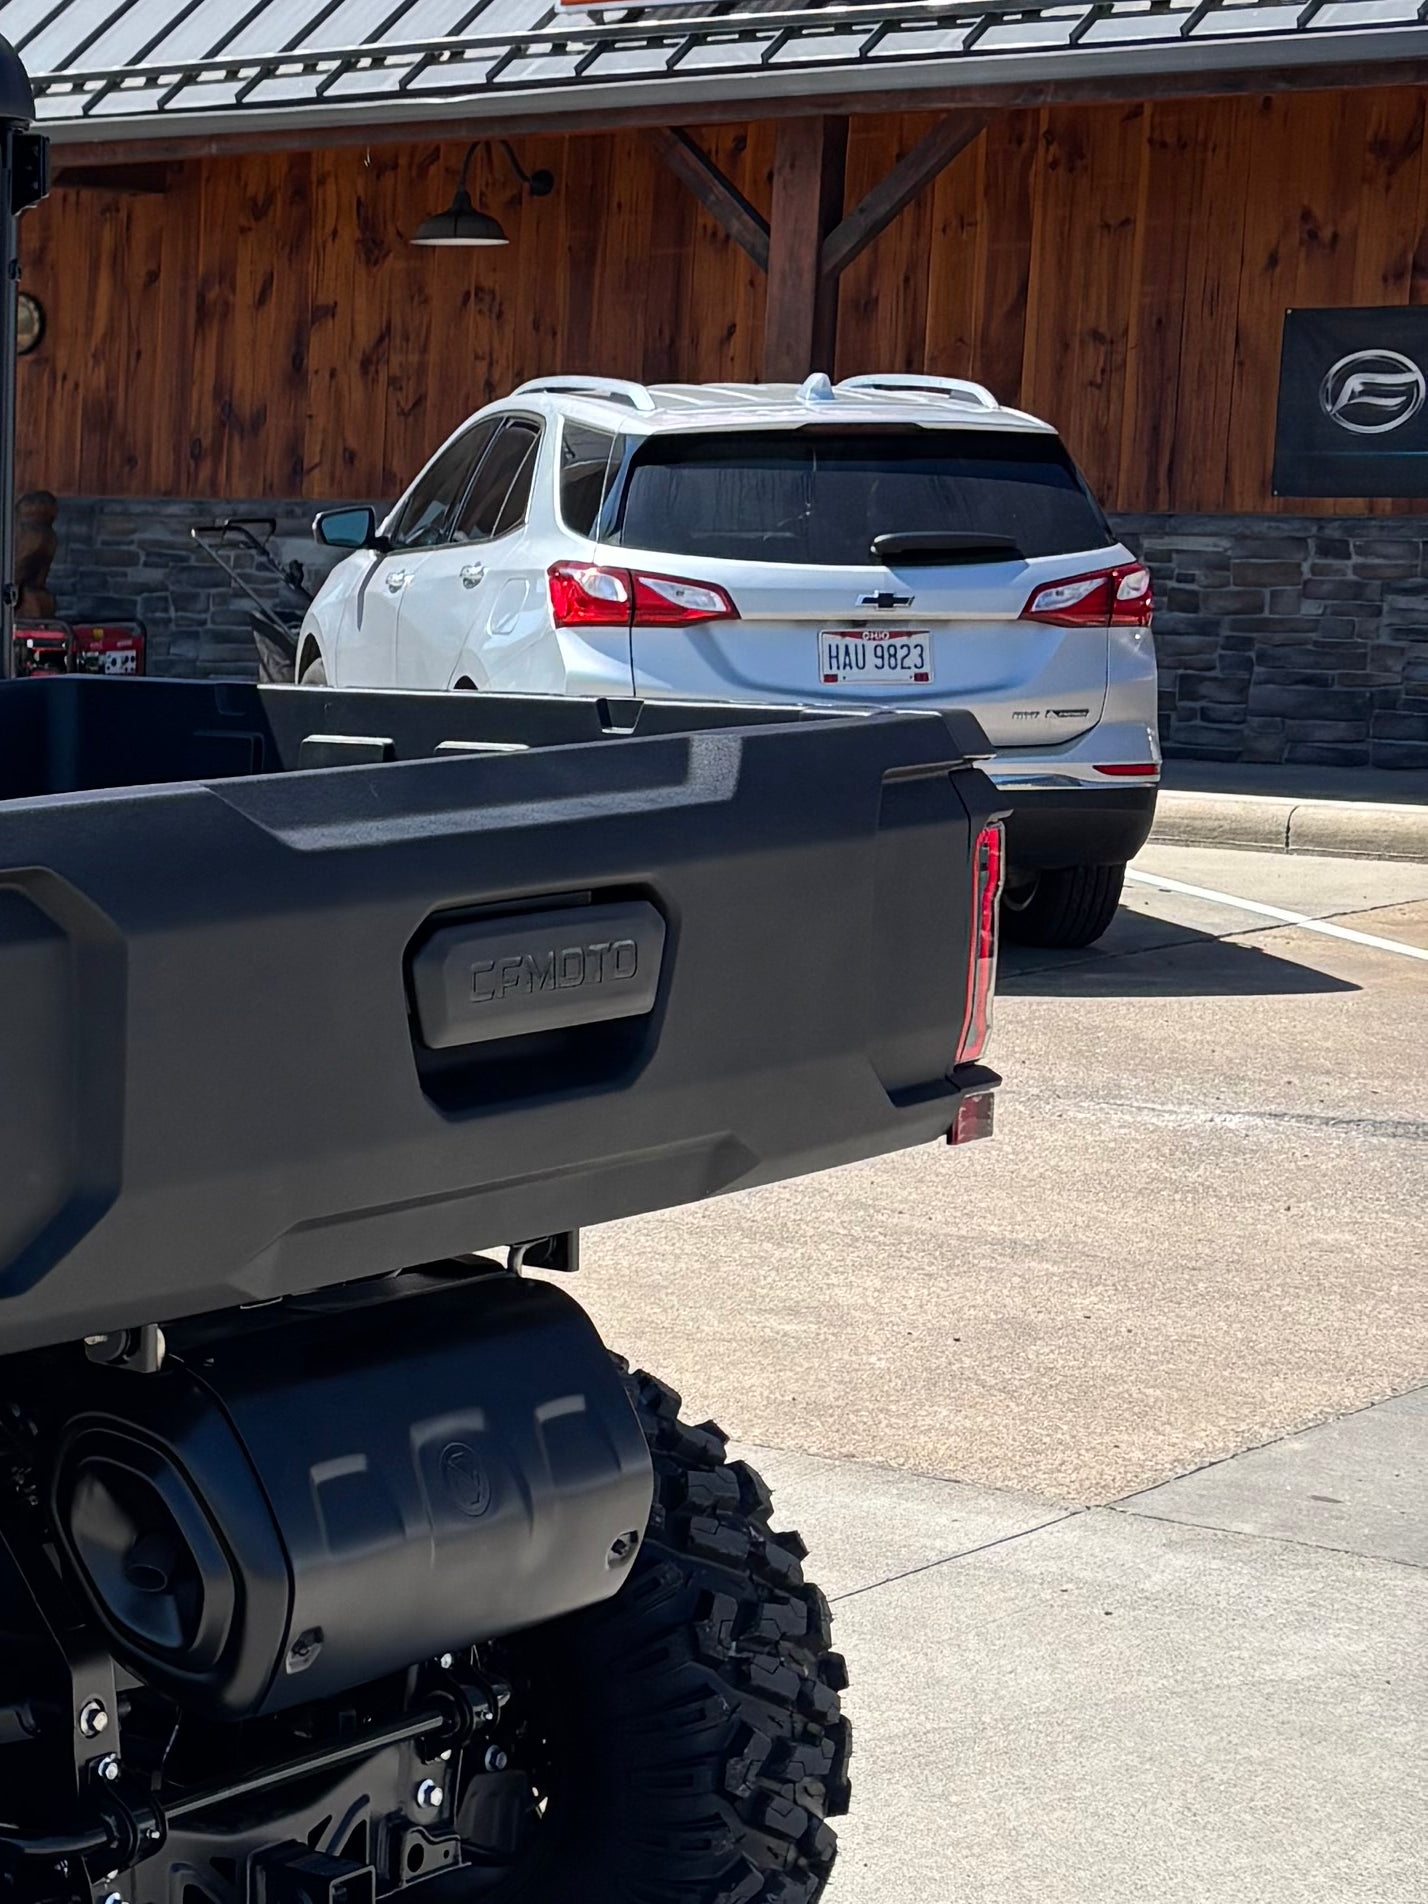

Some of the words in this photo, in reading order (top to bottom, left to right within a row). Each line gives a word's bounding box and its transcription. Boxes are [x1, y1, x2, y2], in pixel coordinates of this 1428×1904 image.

[861, 630, 891, 642] OHIO
[828, 643, 867, 671] HAU
[873, 643, 925, 671] 9823
[470, 939, 638, 1004] CFMOTO
